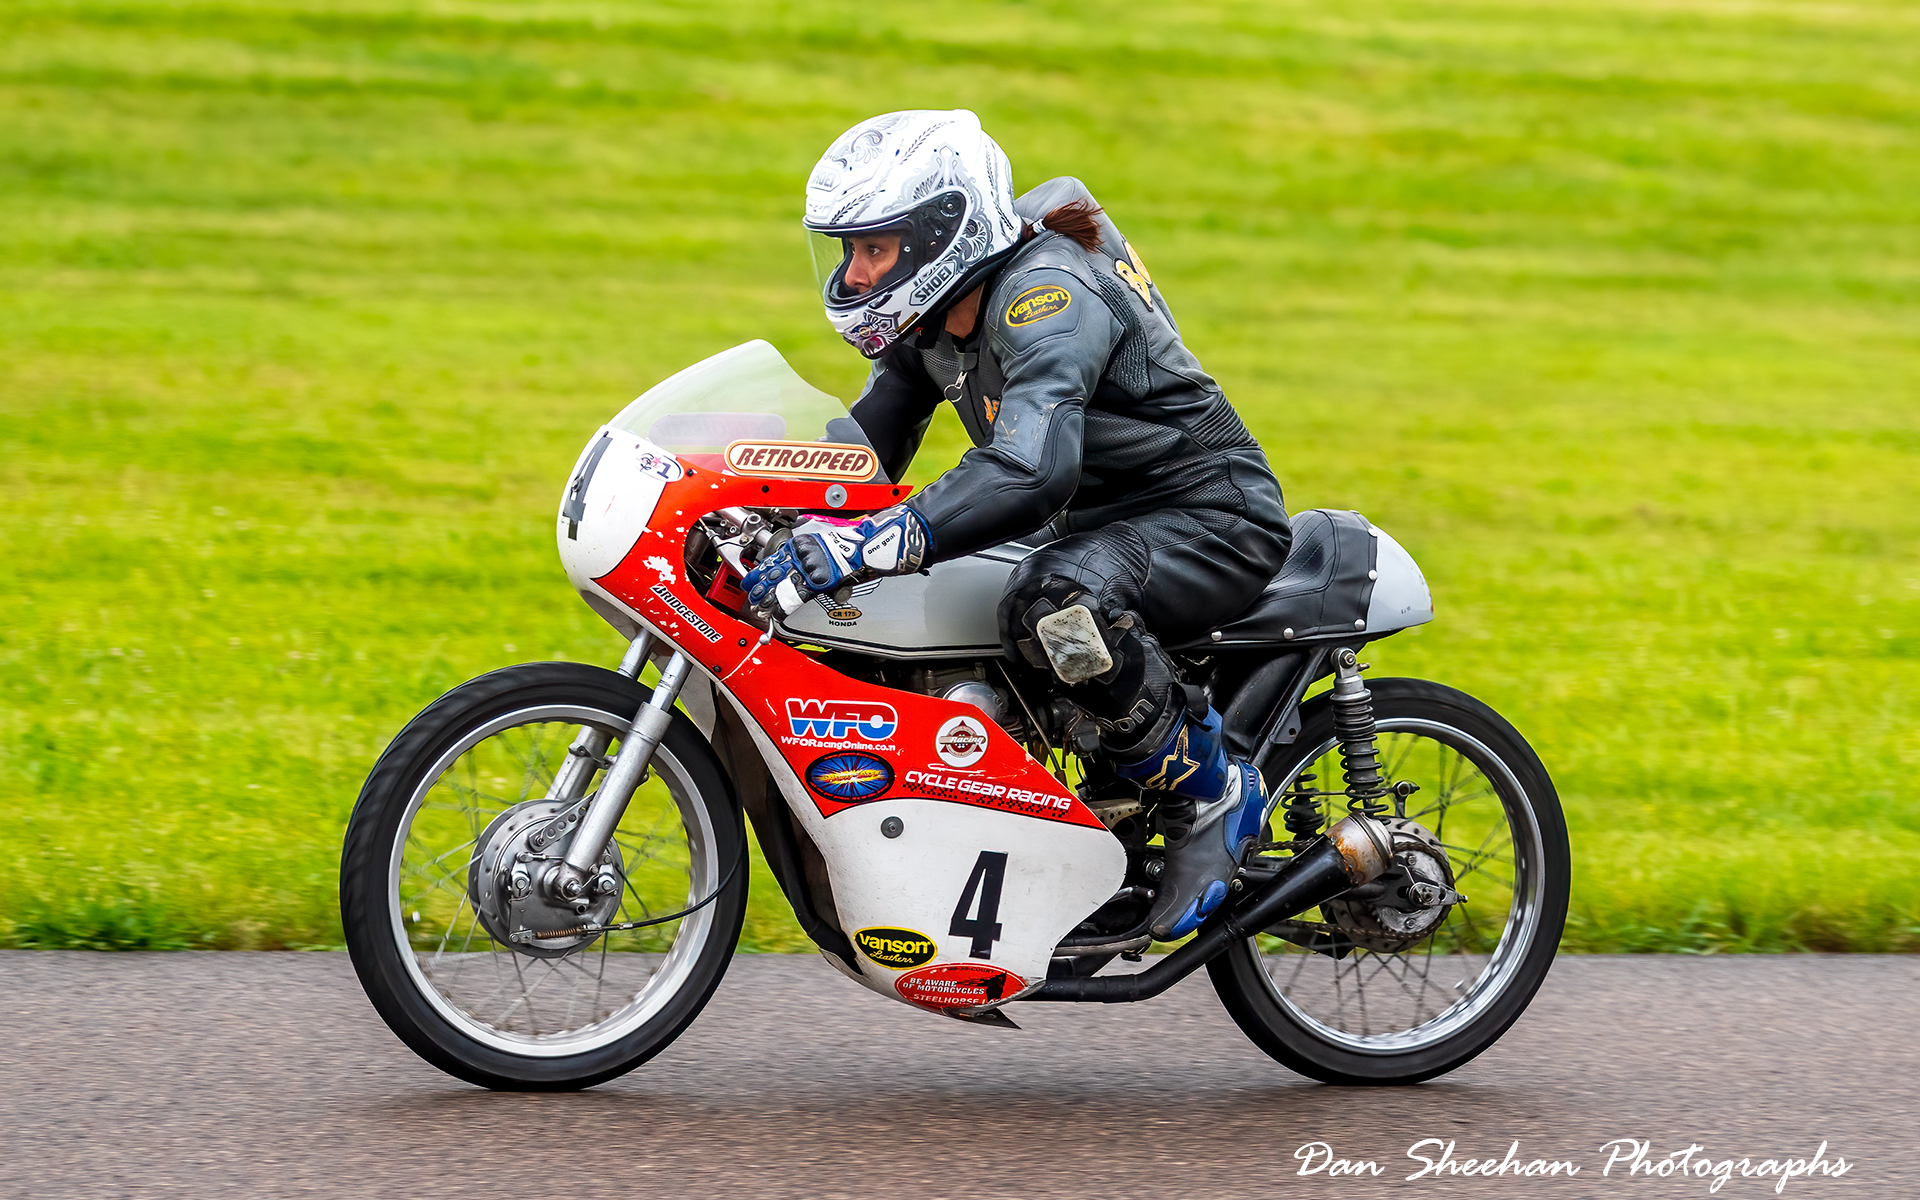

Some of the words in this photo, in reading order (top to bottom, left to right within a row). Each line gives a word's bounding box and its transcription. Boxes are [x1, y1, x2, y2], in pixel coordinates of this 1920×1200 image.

[914, 265, 952, 302] SHOEI
[1010, 291, 1066, 318] vanson
[1023, 304, 1059, 321] Leathers
[736, 447, 869, 472] RETROSPEED
[562, 435, 613, 541] 4
[867, 544, 881, 554] one
[881, 533, 896, 547] goal
[650, 584, 722, 642] BRIDGESTONE
[785, 698, 898, 741] WFO
[950, 735, 985, 746] Racing
[904, 770, 958, 790] CYCLE
[957, 779, 1006, 798] GEAR
[948, 850, 1008, 960] 4
[859, 932, 929, 954] vanson
[869, 949, 914, 964] Leathers
[917, 984, 985, 995] MOTORCYCLES
[924, 979, 958, 987] AWARE
[913, 993, 979, 1005] STEELHORSE
